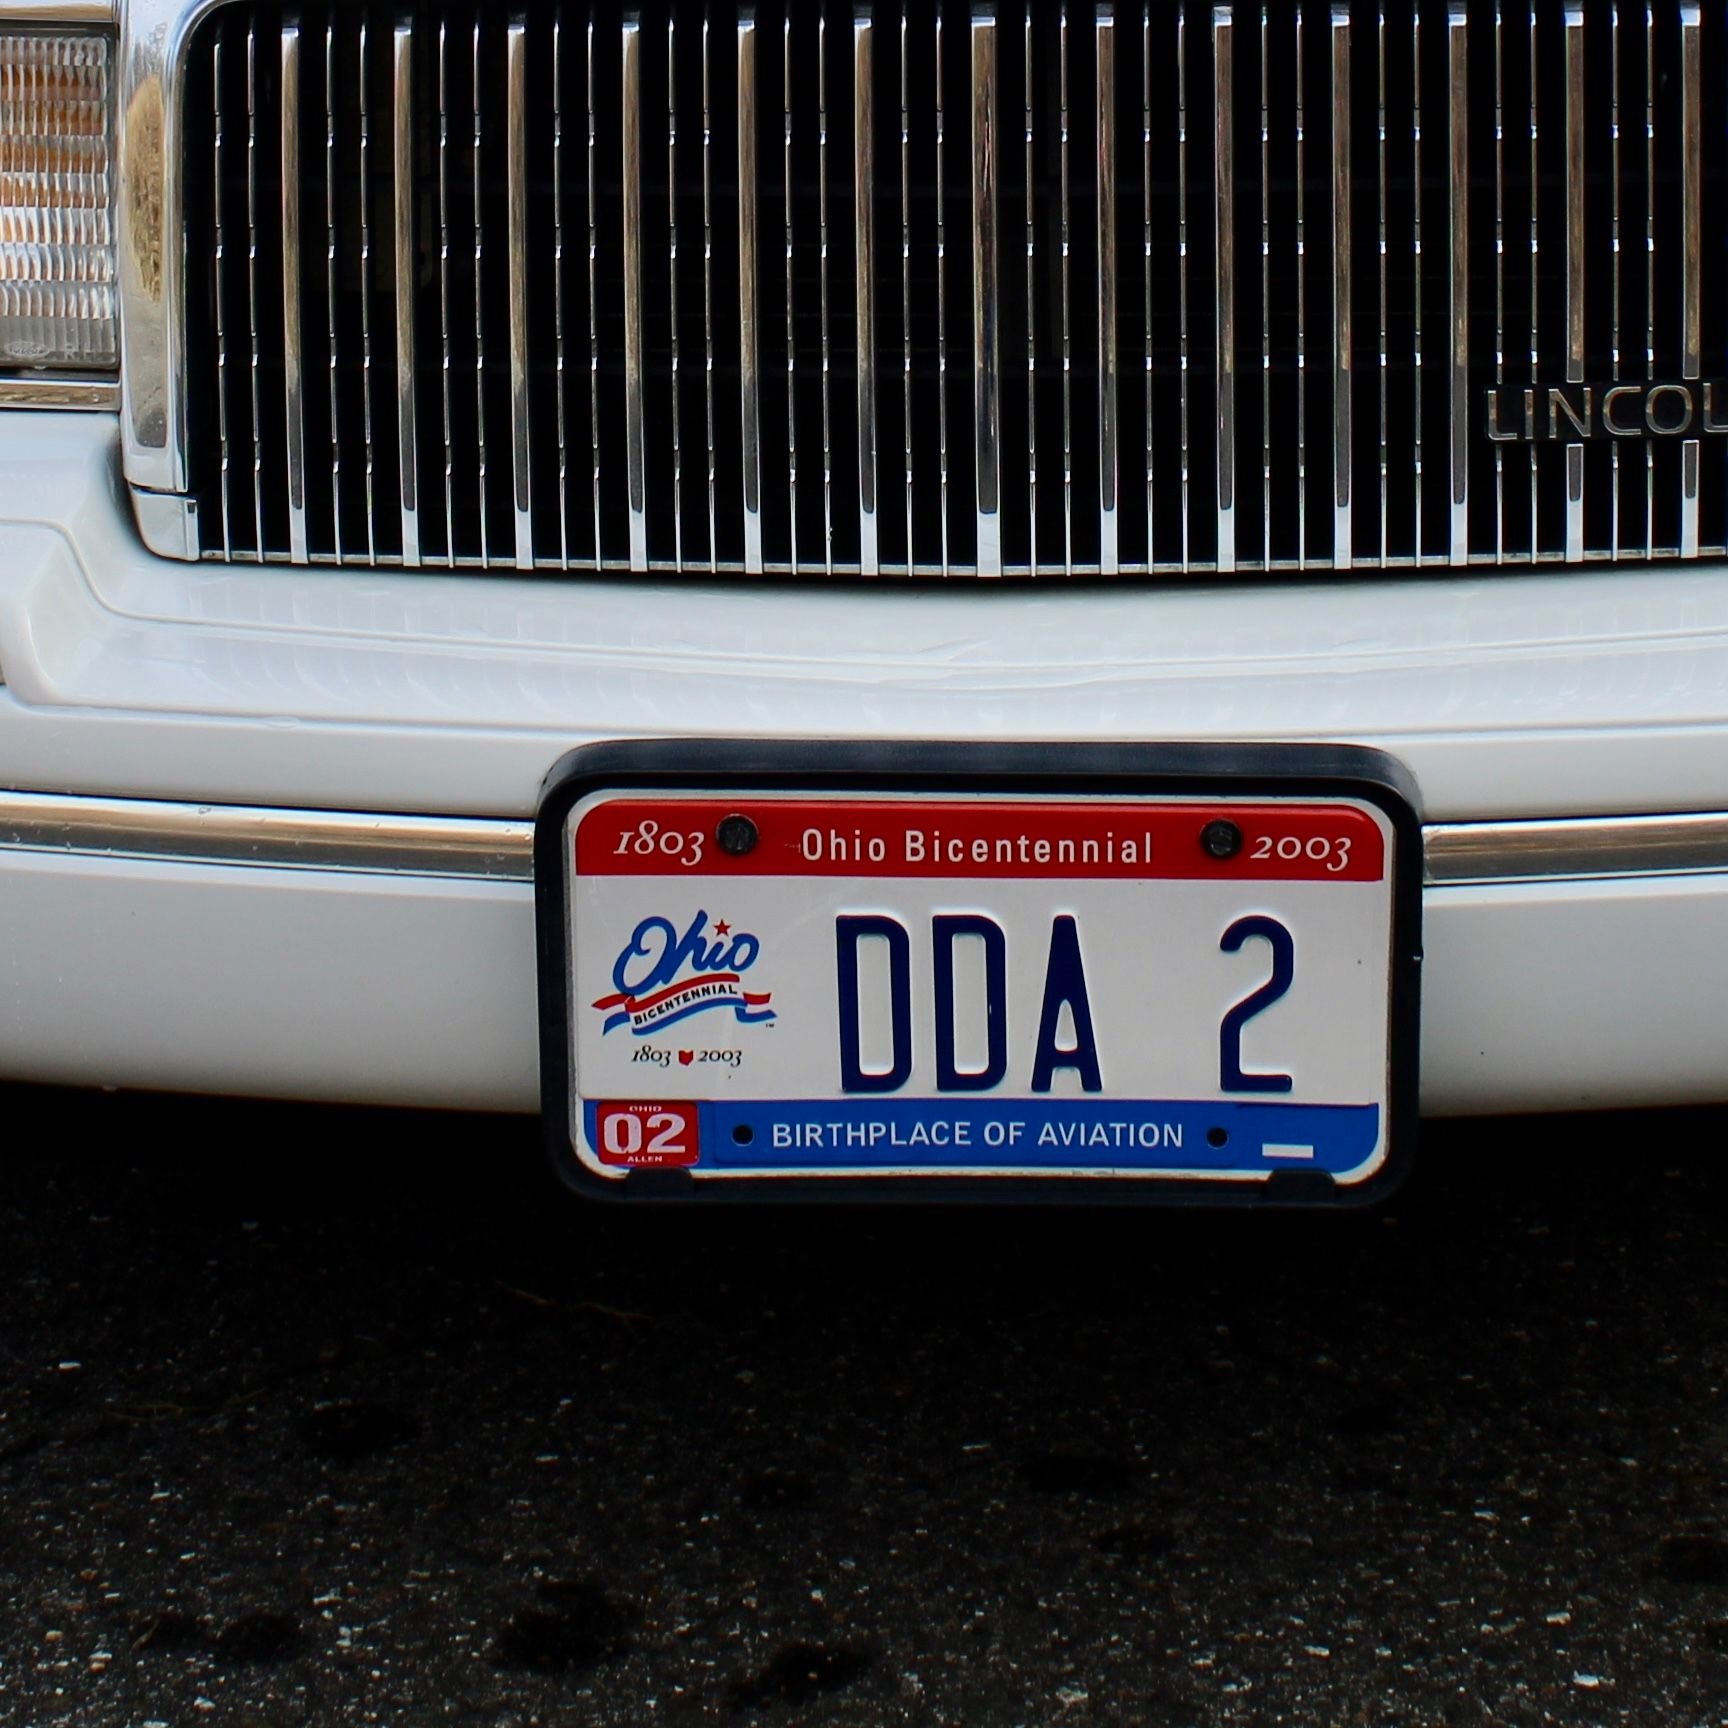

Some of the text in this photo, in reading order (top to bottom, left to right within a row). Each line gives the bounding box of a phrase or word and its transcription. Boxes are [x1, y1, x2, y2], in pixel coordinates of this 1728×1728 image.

[612, 819, 705, 867] 1803
[802, 828, 1153, 864] Ohio Bicentennial
[1249, 834, 1353, 872] 2003
[612, 909, 760, 997] Ohio
[633, 984, 738, 1026] BICENTENNIAL
[835, 913, 1296, 1095] DDA 2
[632, 1044, 743, 1068] 1803 2003
[603, 1113, 686, 1154] 02
[772, 1120, 1184, 1149] BIRTHPLACE OF AVIATION
[627, 1155, 663, 1163] ALLEN
